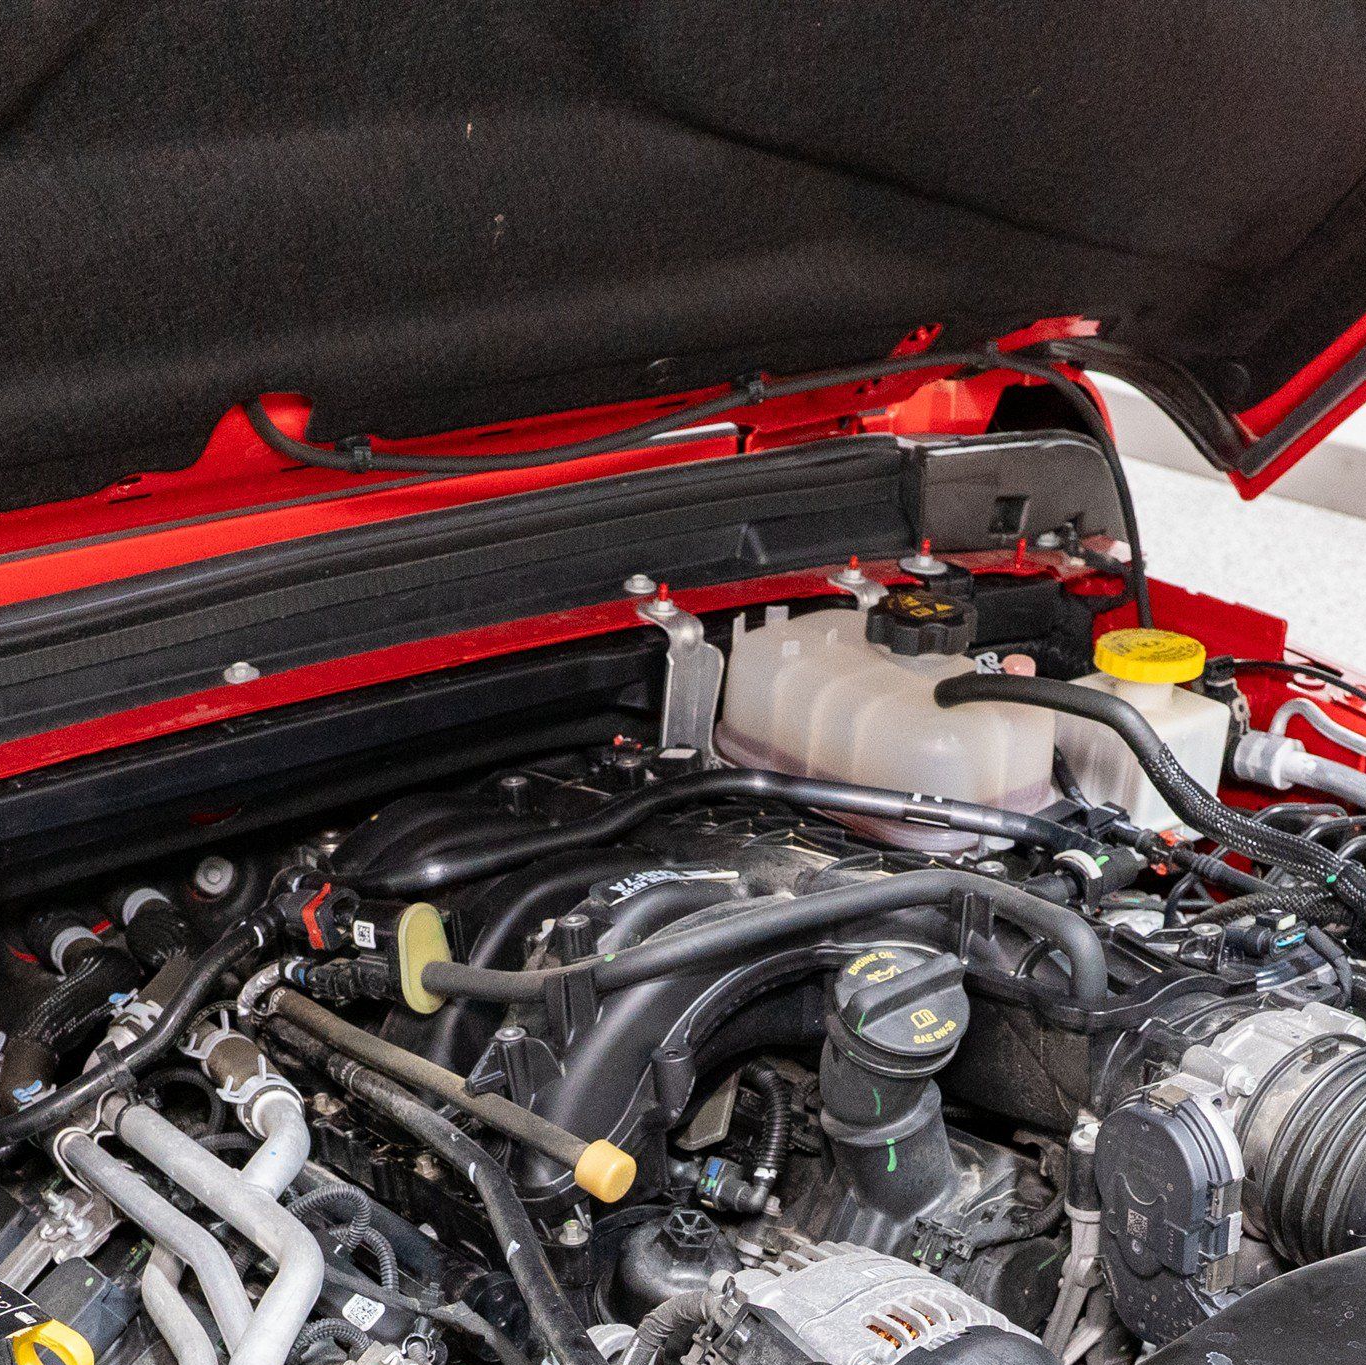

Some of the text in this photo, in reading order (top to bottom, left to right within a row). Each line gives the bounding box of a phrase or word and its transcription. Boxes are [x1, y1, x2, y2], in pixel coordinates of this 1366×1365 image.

[848, 951, 897, 976] ENGINE OIL
[913, 1019, 957, 1045] SAE 0W-20
